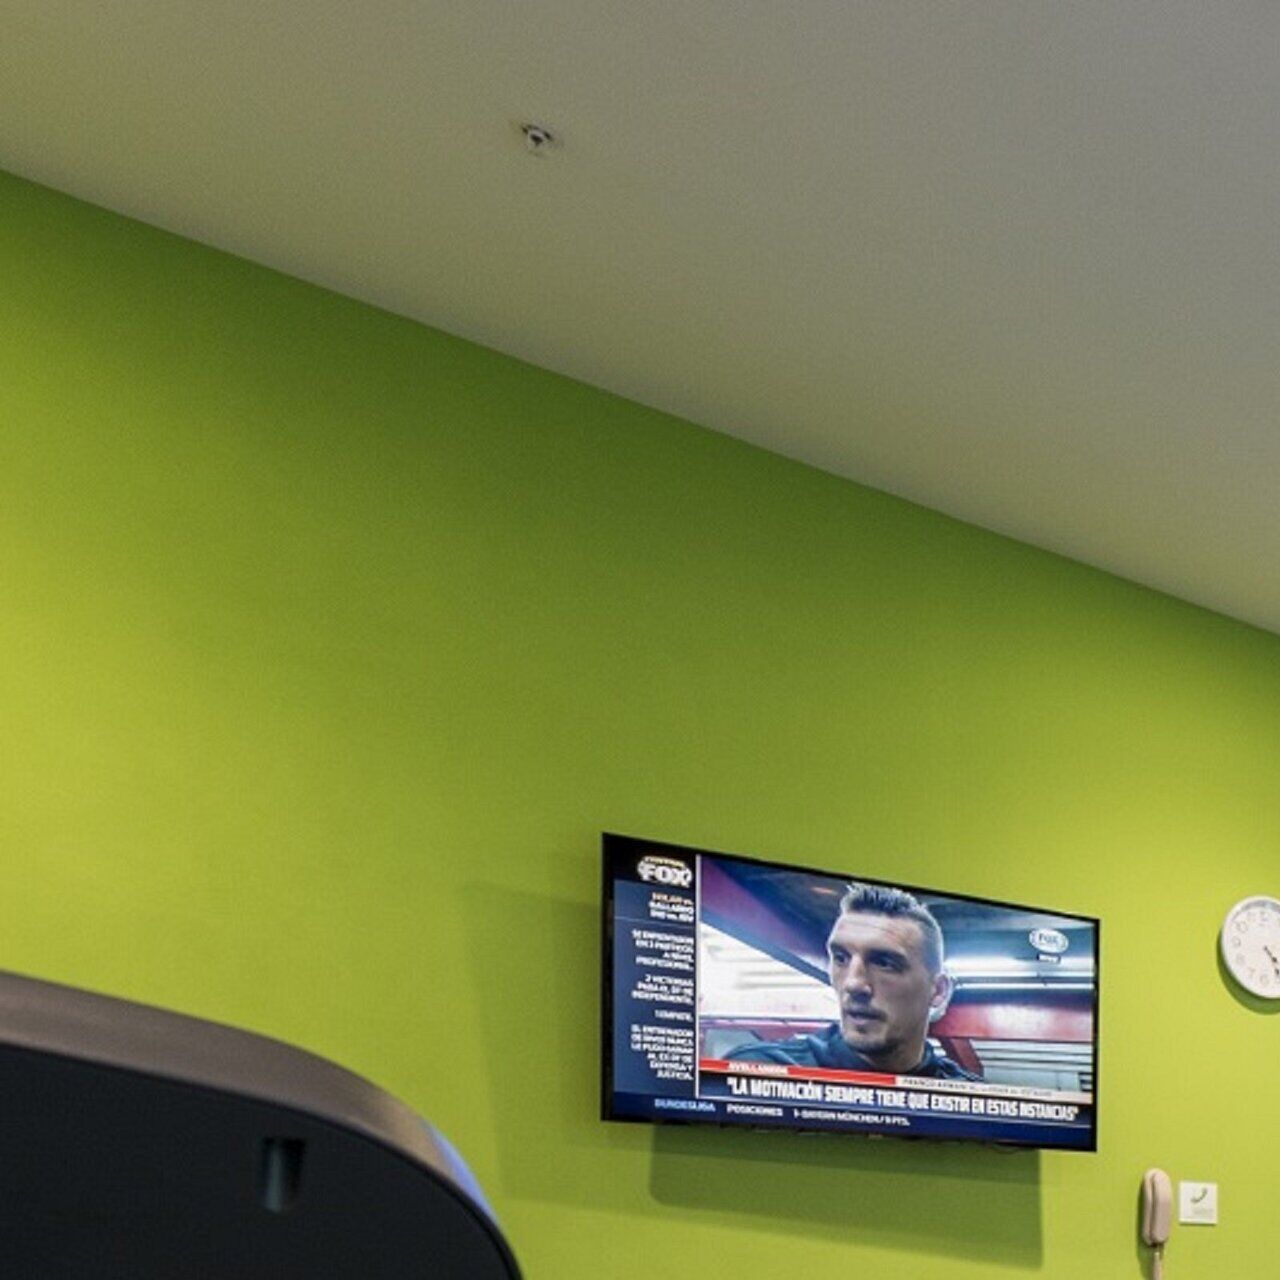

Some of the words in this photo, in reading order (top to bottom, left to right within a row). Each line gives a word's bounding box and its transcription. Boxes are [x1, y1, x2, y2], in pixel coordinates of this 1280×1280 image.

[641, 864, 691, 888] FOX
[751, 1080, 822, 1101] MOTIVACIÓN
[825, 1086, 875, 1105] SIEMPRE
[877, 1089, 907, 1106] TIENE
[907, 1092, 929, 1110] QUE
[931, 1094, 970, 1113] EXISTIR
[972, 1098, 984, 1113] EN
[986, 1100, 1019, 1117] ESTAS
